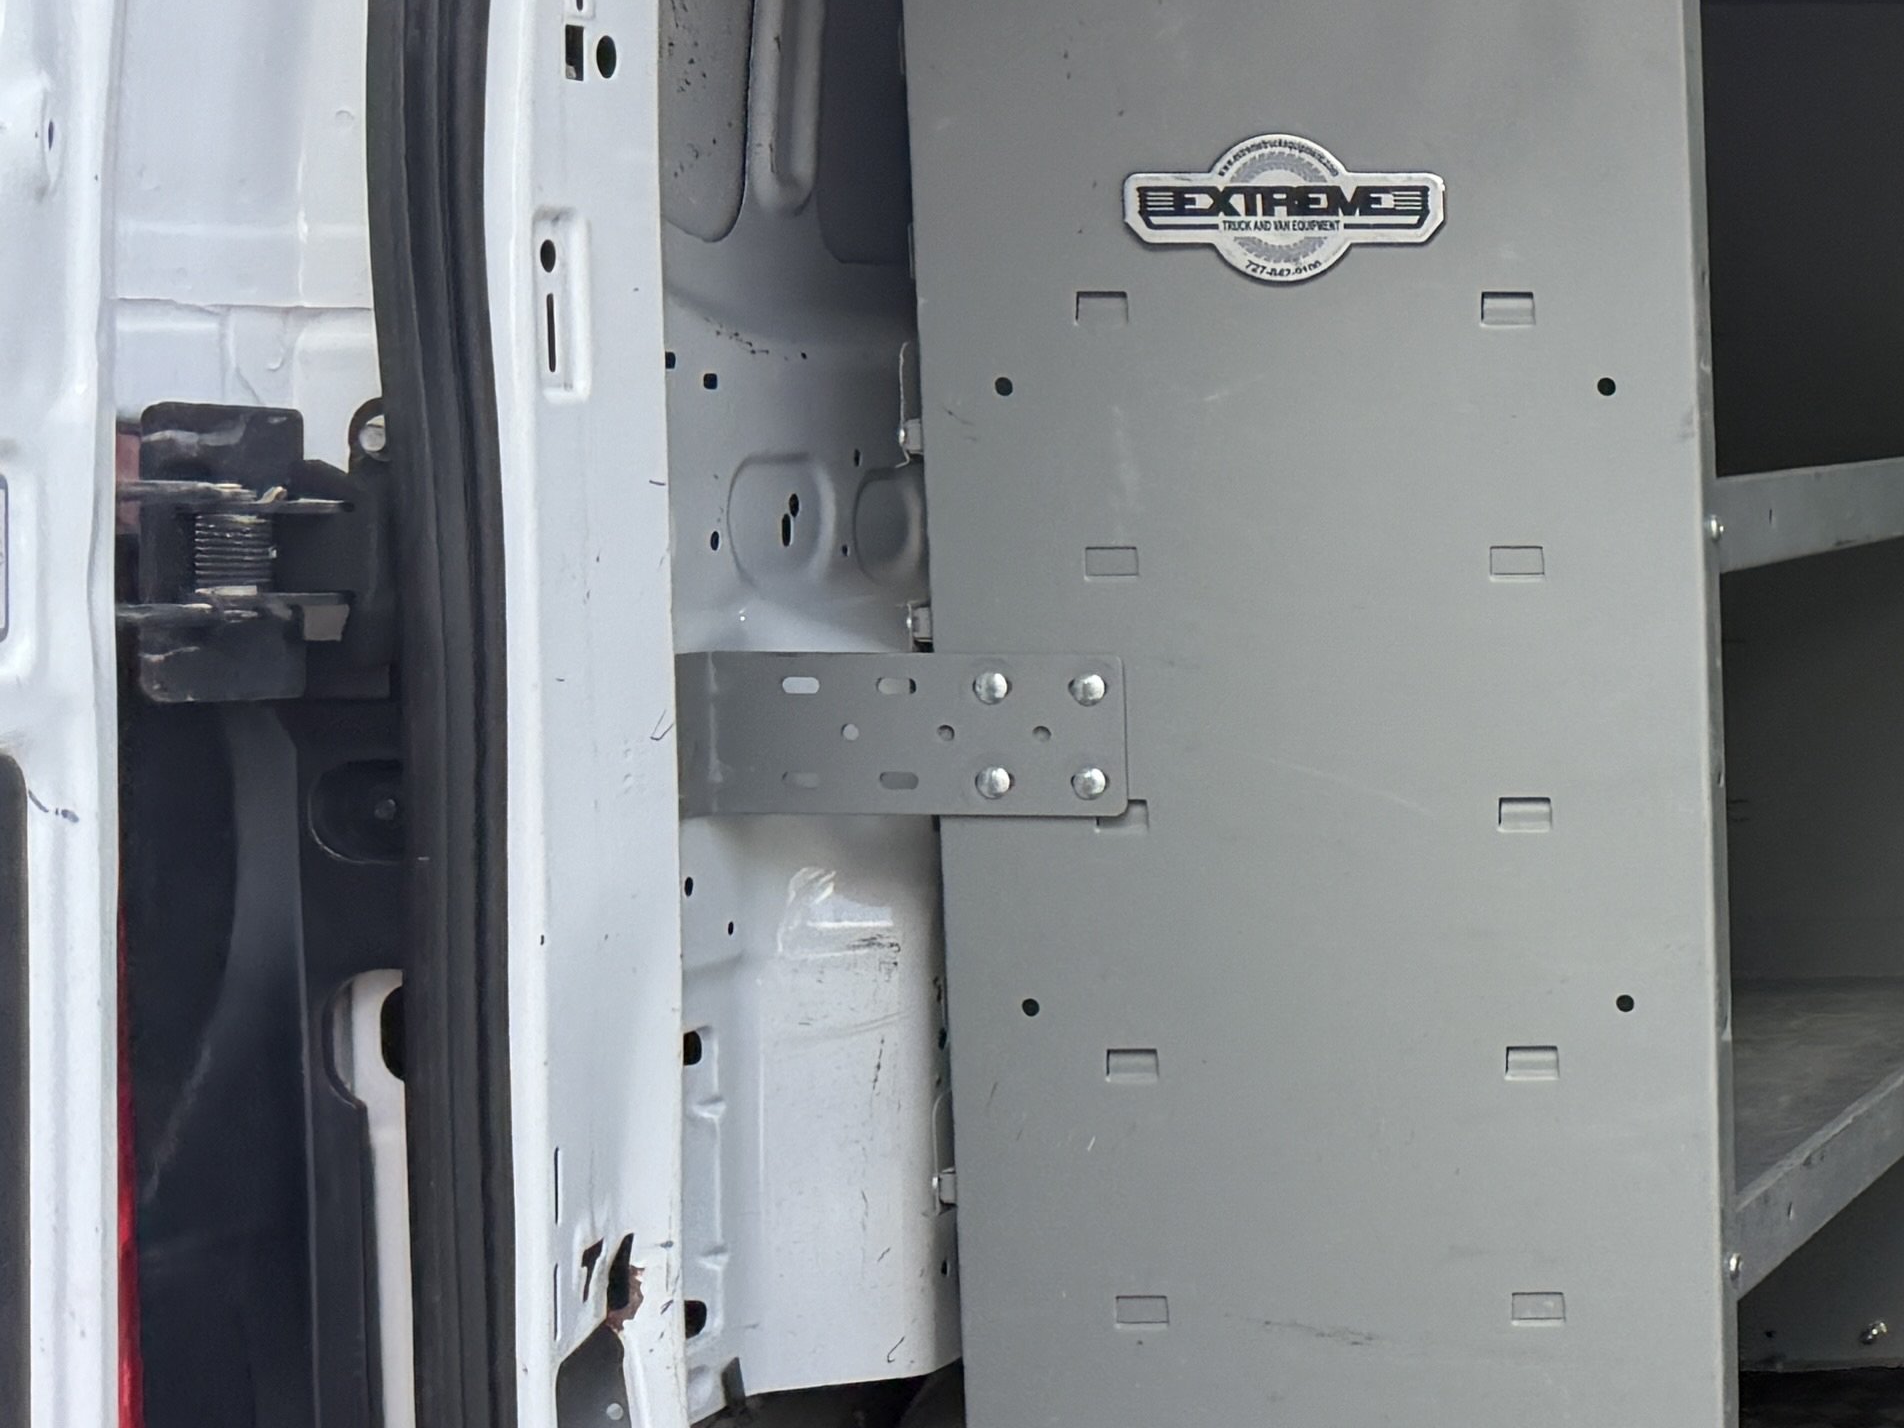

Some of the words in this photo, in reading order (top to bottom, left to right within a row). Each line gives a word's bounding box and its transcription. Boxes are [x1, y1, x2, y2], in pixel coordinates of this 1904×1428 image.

[1165, 185, 1400, 217] EXTREME
[1222, 219, 1252, 231] TRUCK
[1253, 219, 1271, 231] AND
[1273, 219, 1290, 231] VAN
[1292, 219, 1341, 231] EQUIPMENT
